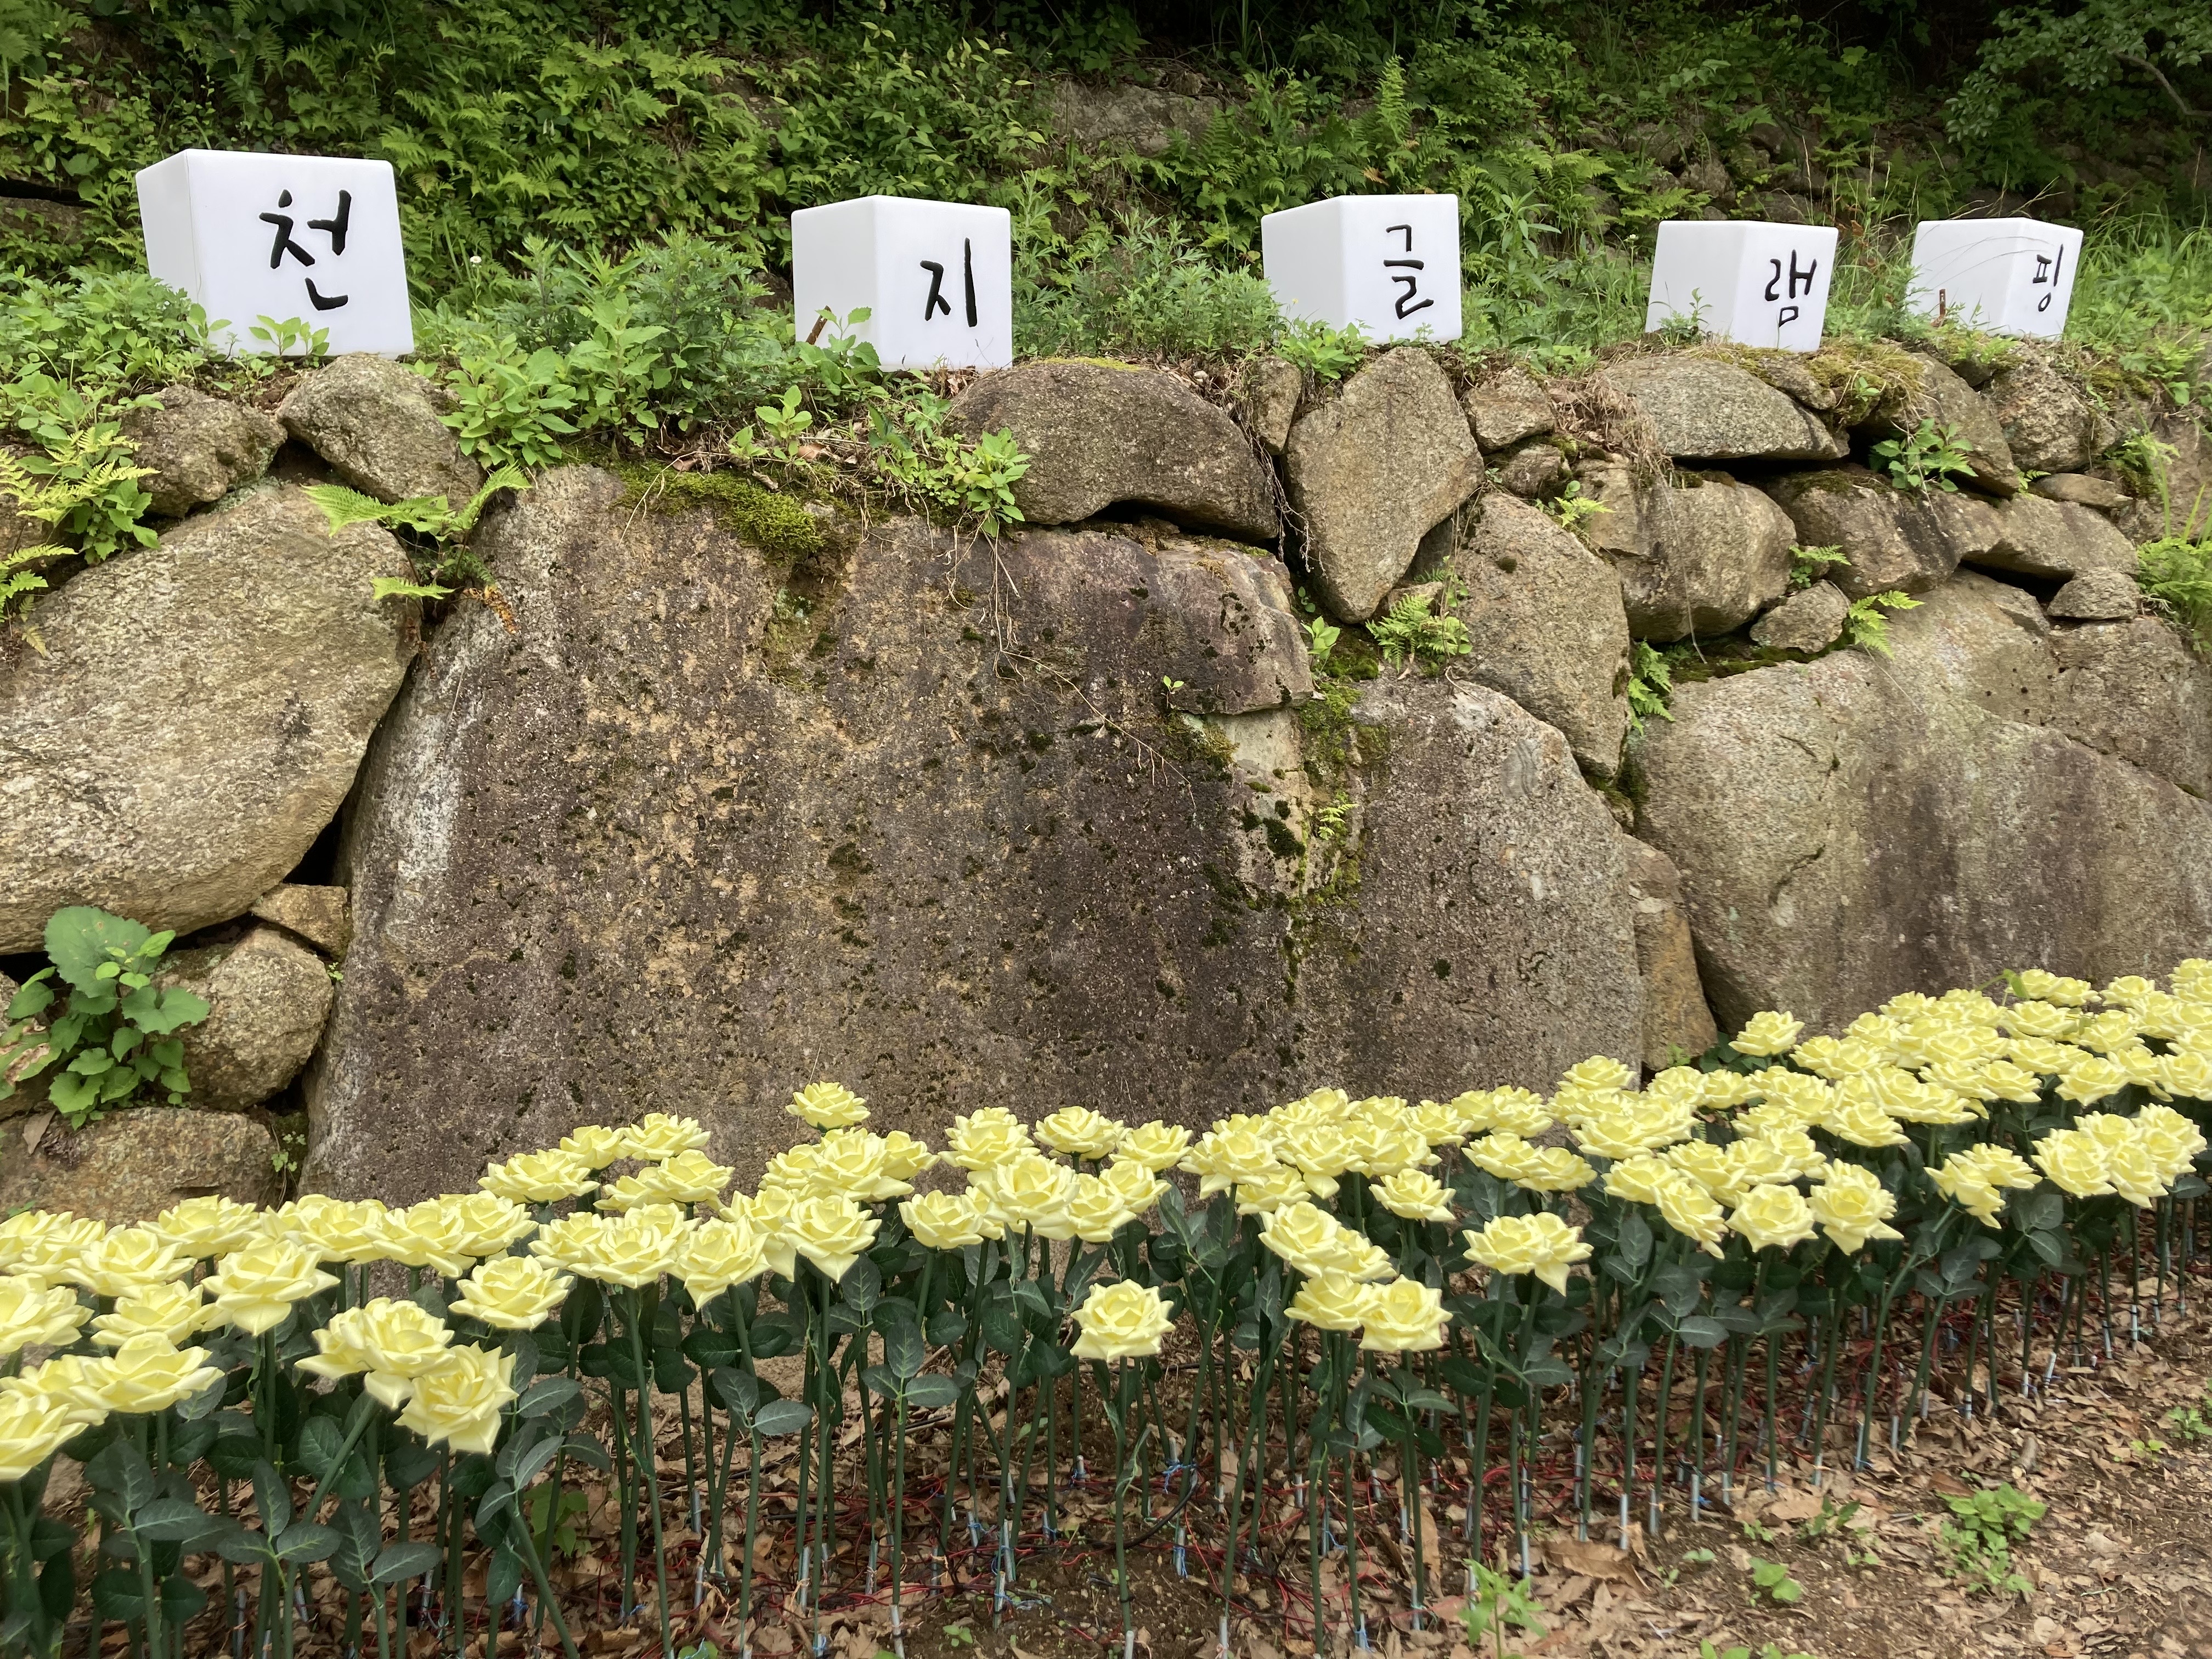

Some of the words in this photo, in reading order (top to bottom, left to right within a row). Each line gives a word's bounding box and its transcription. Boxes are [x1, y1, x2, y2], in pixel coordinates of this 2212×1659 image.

[258, 189, 352, 312] 천
[919, 237, 978, 328] 지
[1383, 224, 1435, 320] 글
[1764, 249, 1818, 329] 램
[2032, 244, 2064, 313] 핑
